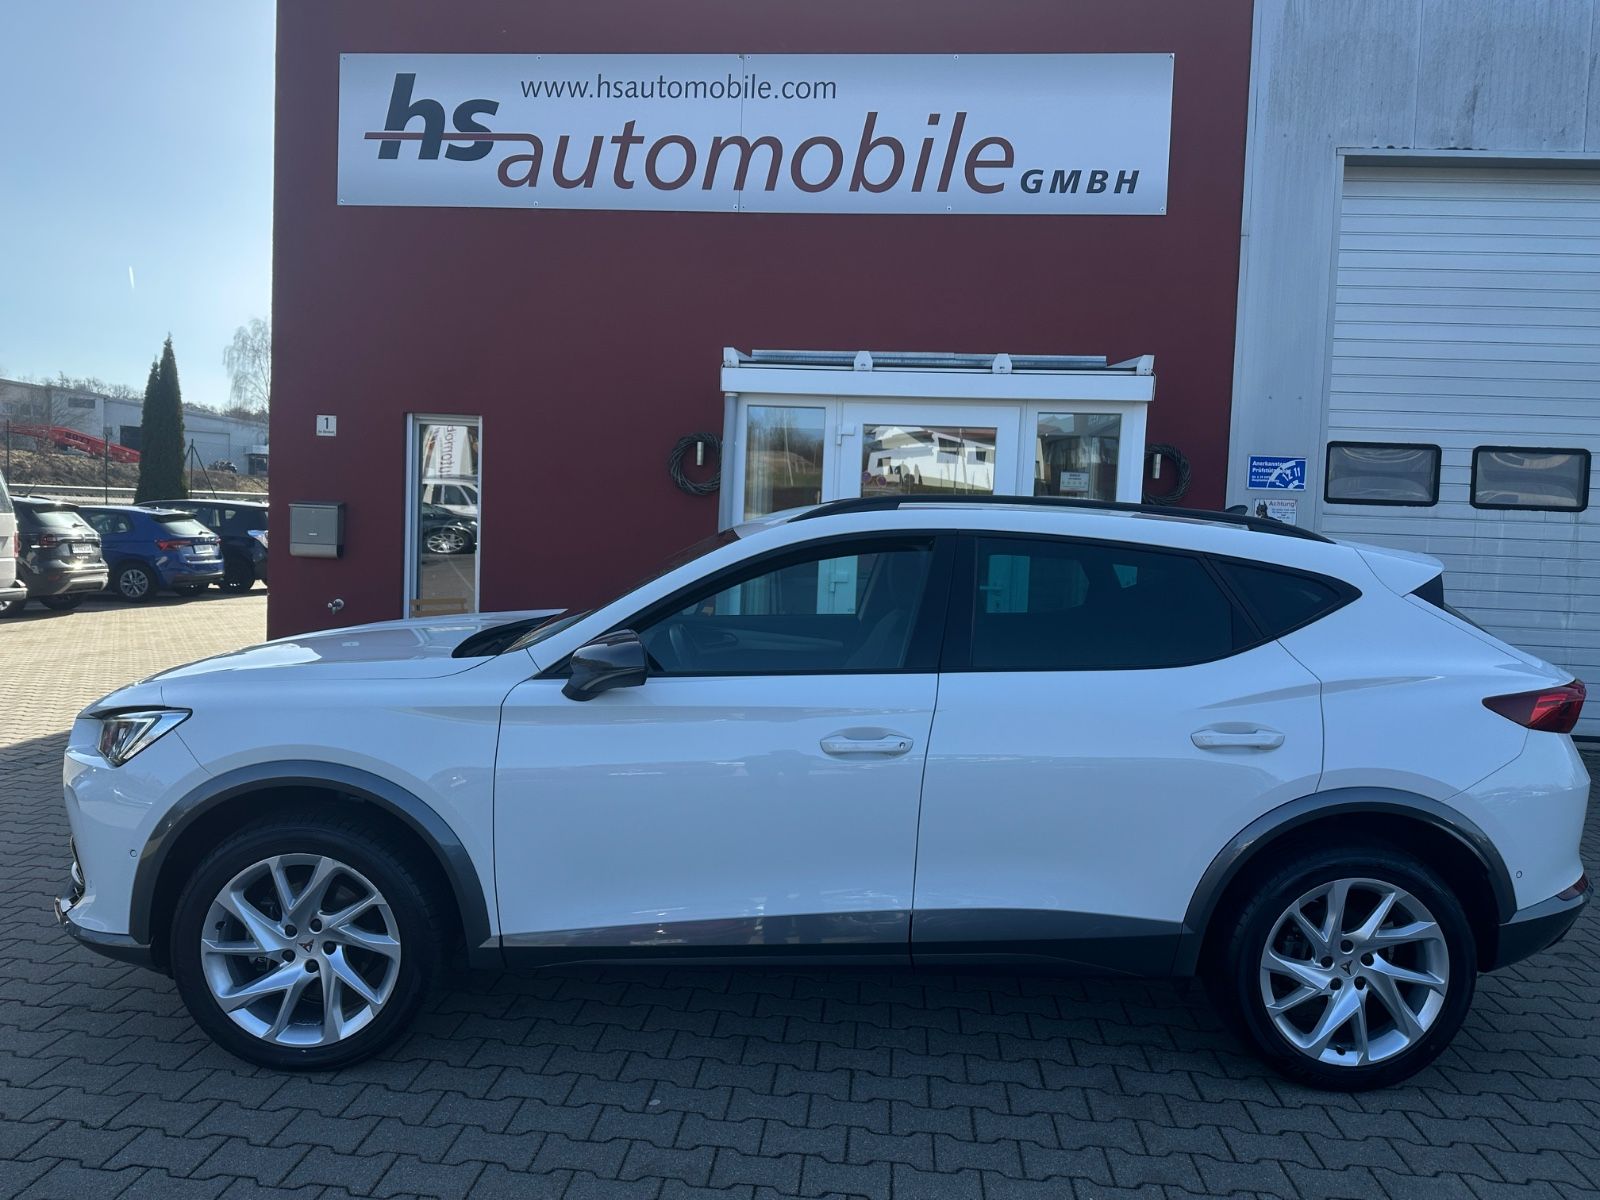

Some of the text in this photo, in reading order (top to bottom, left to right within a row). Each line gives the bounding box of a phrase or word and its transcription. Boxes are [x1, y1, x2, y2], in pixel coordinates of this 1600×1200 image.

[520, 73, 838, 100] www.hsautomobile.com
[377, 72, 1141, 195] hs automobile GMBH
[324, 417, 329, 430] 1
